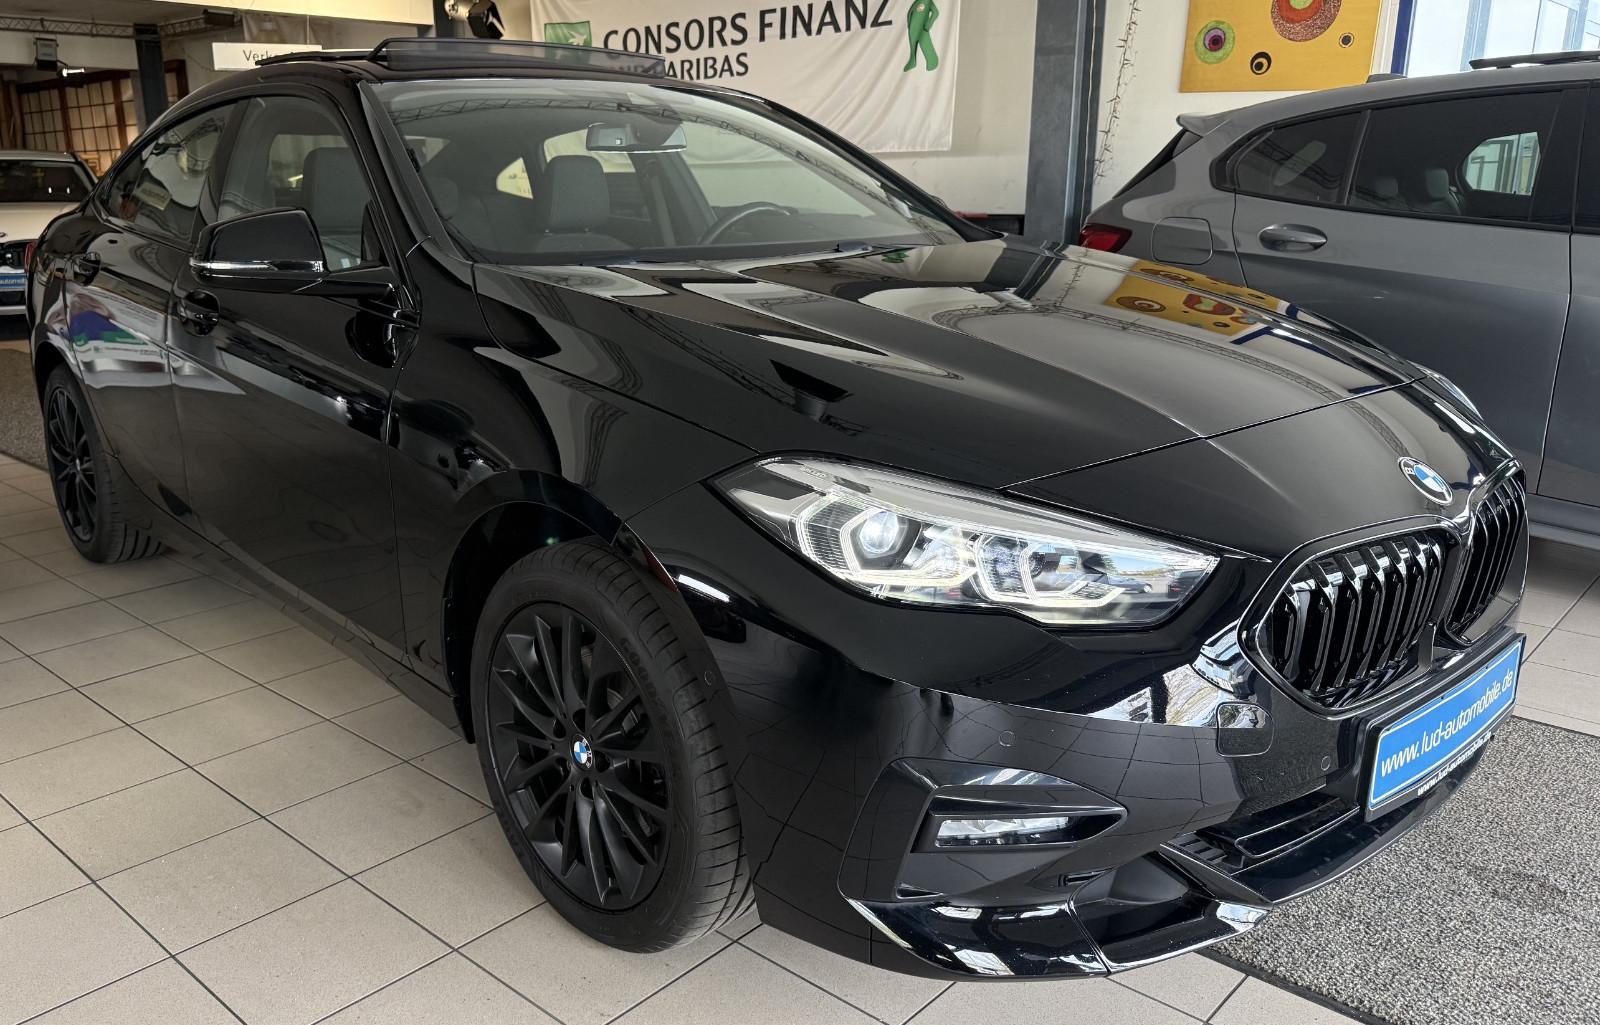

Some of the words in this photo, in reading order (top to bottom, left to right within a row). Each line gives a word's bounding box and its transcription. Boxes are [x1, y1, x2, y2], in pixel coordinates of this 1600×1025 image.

[603, 12, 748, 59] CONSORS
[759, 0, 893, 42] FINANZ
[660, 53, 749, 80] ARIBAS
[1381, 669, 1514, 777] www.lud-automobile.de
